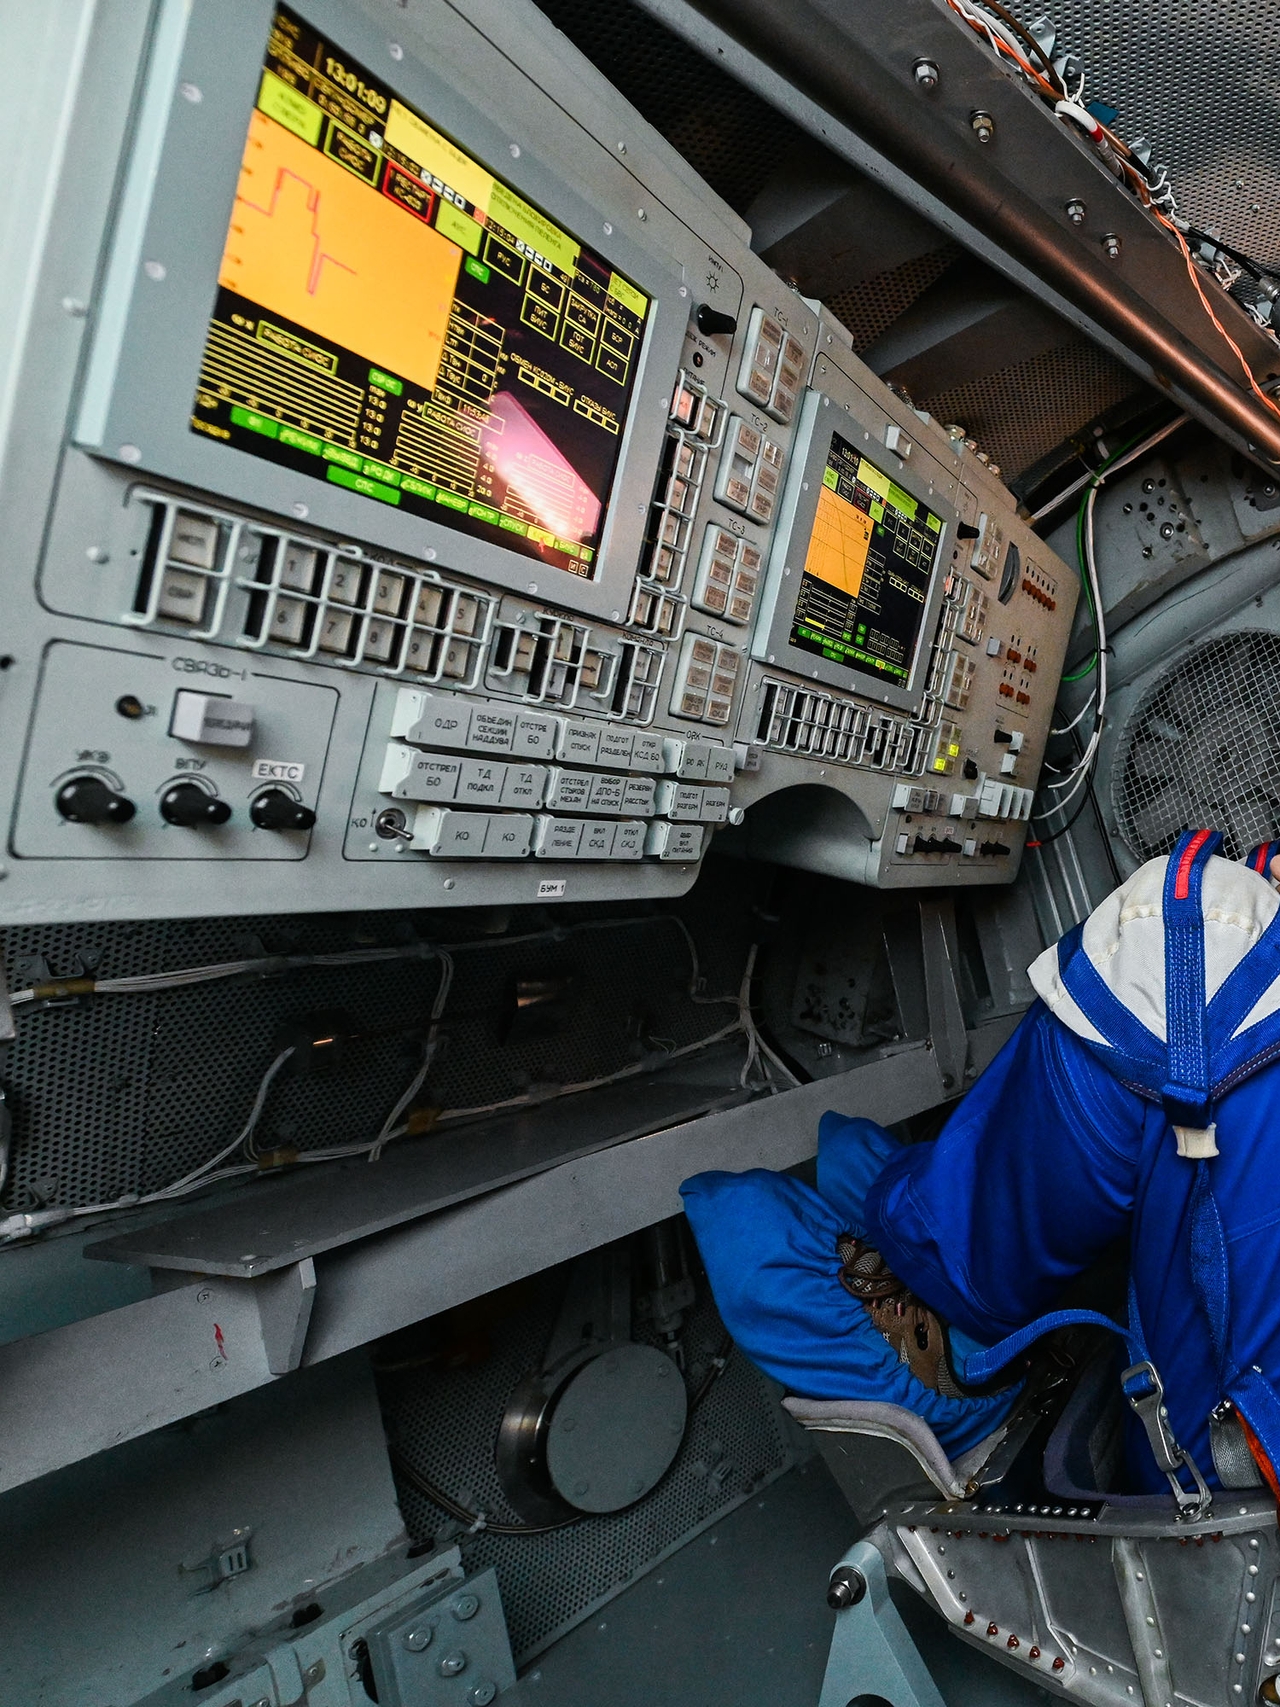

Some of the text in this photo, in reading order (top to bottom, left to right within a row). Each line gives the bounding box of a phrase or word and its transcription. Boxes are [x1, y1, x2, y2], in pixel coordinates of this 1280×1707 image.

[326, 57, 387, 114] 13:01:09
[496, 251, 511, 267] РУС
[541, 282, 551, 295] БС
[534, 306, 548, 320] ПИТ
[571, 298, 597, 322] ЗАКРУТКА
[530, 315, 548, 331] БИУС
[774, 307, 789, 327] ТС-1
[573, 331, 585, 345] ГОТ
[611, 333, 624, 346] БСР
[568, 339, 585, 355] БИУС
[606, 359, 618, 372] АСП
[581, 394, 602, 412] ОТКАЗЫ
[751, 413, 768, 432] ТС-2
[728, 518, 746, 535] ТС-3
[335, 574, 344, 588] 2
[379, 586, 388, 598] 3
[457, 608, 465, 620] 5
[277, 611, 456, 662] 6 7 8 9 0
[707, 624, 724, 639] ТС-4
[171, 656, 247, 681] СВЯЗЬ-1
[435, 718, 458, 729] ОДР
[476, 714, 513, 727] ОБЪЕДИН
[478, 724, 508, 736] СЕКЦИИ
[568, 728, 597, 740] ПРИЗНАК
[472, 734, 510, 746] НАДДУВА
[606, 733, 630, 744] ПОДГОТ
[571, 742, 591, 752] СПУСК
[600, 746, 631, 758] РАЗДЕЛЕН
[634, 748, 650, 760] КСД
[175, 757, 207, 771] ВПУ
[417, 761, 457, 773] ОТСТРЕЛ
[258, 763, 300, 779] ЕКТС
[478, 768, 492, 780] ТД
[426, 776, 441, 786] БО
[520, 772, 533, 784] ТД
[560, 777, 589, 787] ОТСТРЕЛ
[600, 777, 621, 785] ВЫБОР
[467, 782, 494, 792] ПОДКЛ
[513, 786, 532, 796] ОТКЛ
[560, 786, 585, 796] СТЫКОВ
[560, 795, 582, 804] МЕХАН
[680, 791, 699, 799] ПОДГОТ
[600, 799, 620, 807] СПУСК
[351, 818, 367, 828] КО
[455, 831, 470, 841] КО
[502, 832, 516, 842] КО
[589, 839, 605, 849] СКД
[620, 840, 636, 849] СКД
[540, 884, 558, 893] БУМ
